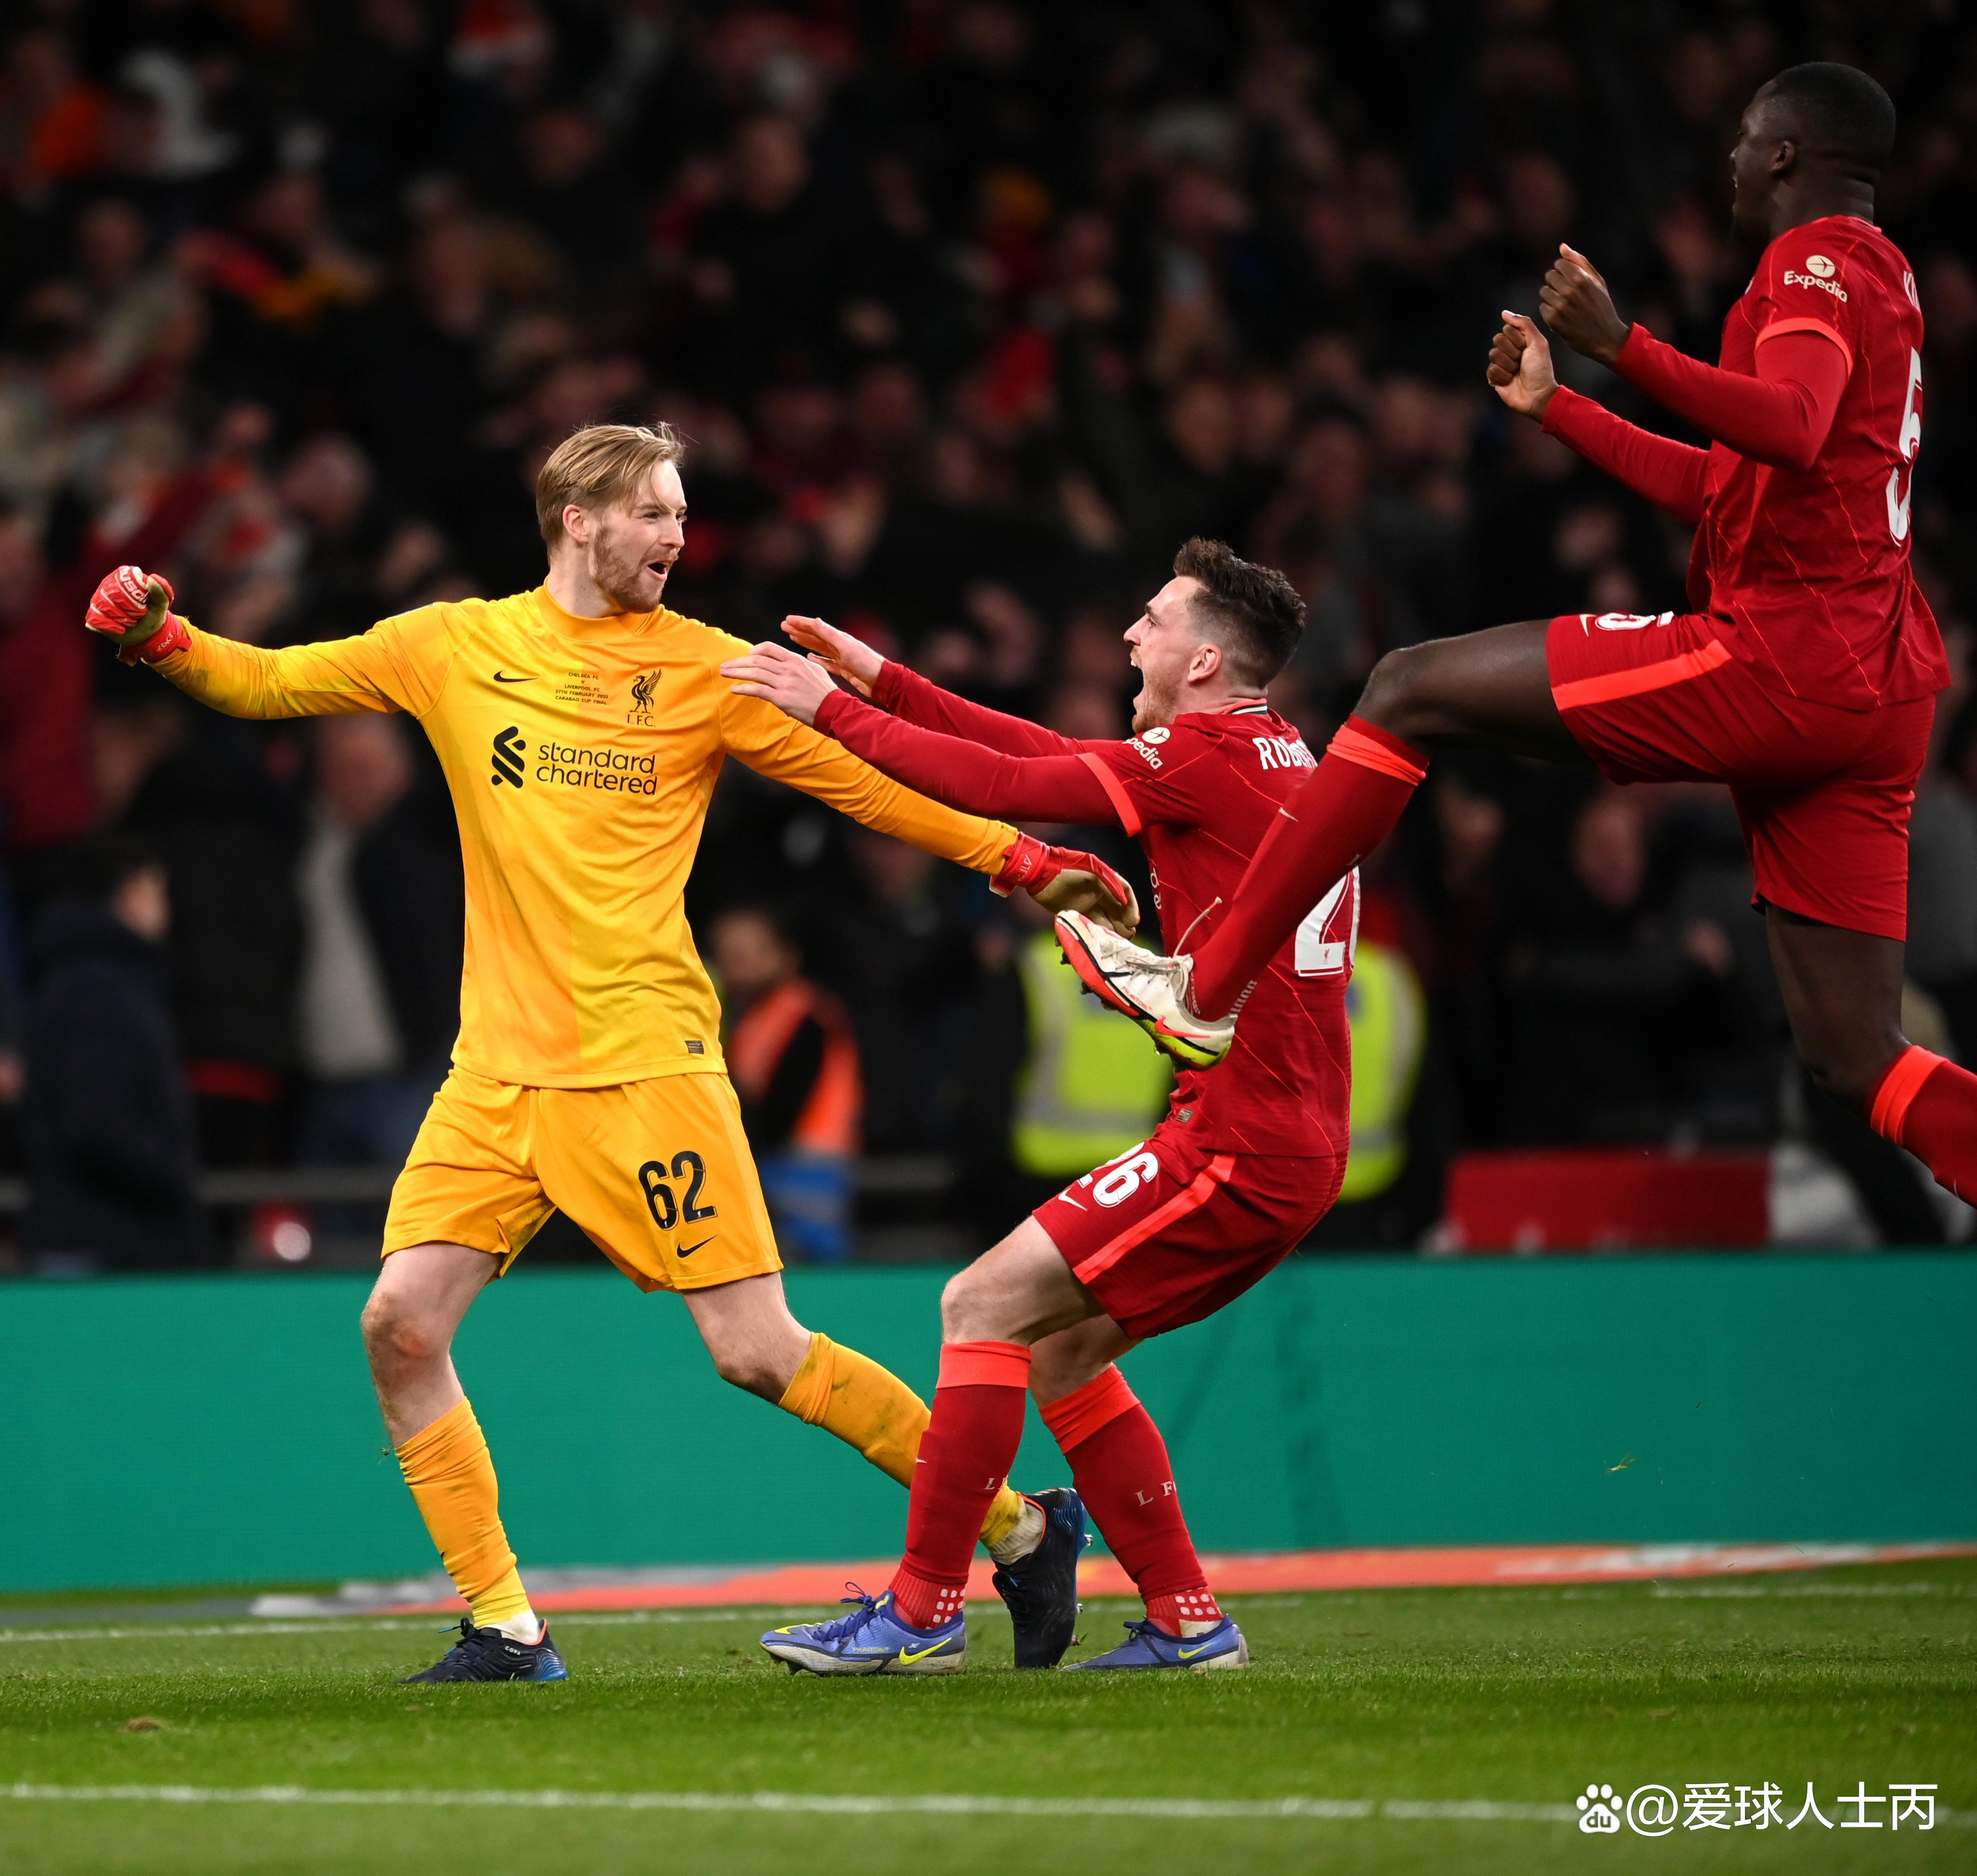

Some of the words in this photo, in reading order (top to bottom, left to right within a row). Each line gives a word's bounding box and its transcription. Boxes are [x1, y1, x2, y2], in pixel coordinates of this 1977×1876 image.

[1784, 270, 1848, 303] Expedia
[1886, 347, 1923, 547] 5
[538, 742, 655, 774] standard
[1121, 737, 1164, 770] pedia
[536, 764, 658, 796] chartered
[638, 1150, 719, 1231] 62
[505, 1645, 521, 1656] COPA
